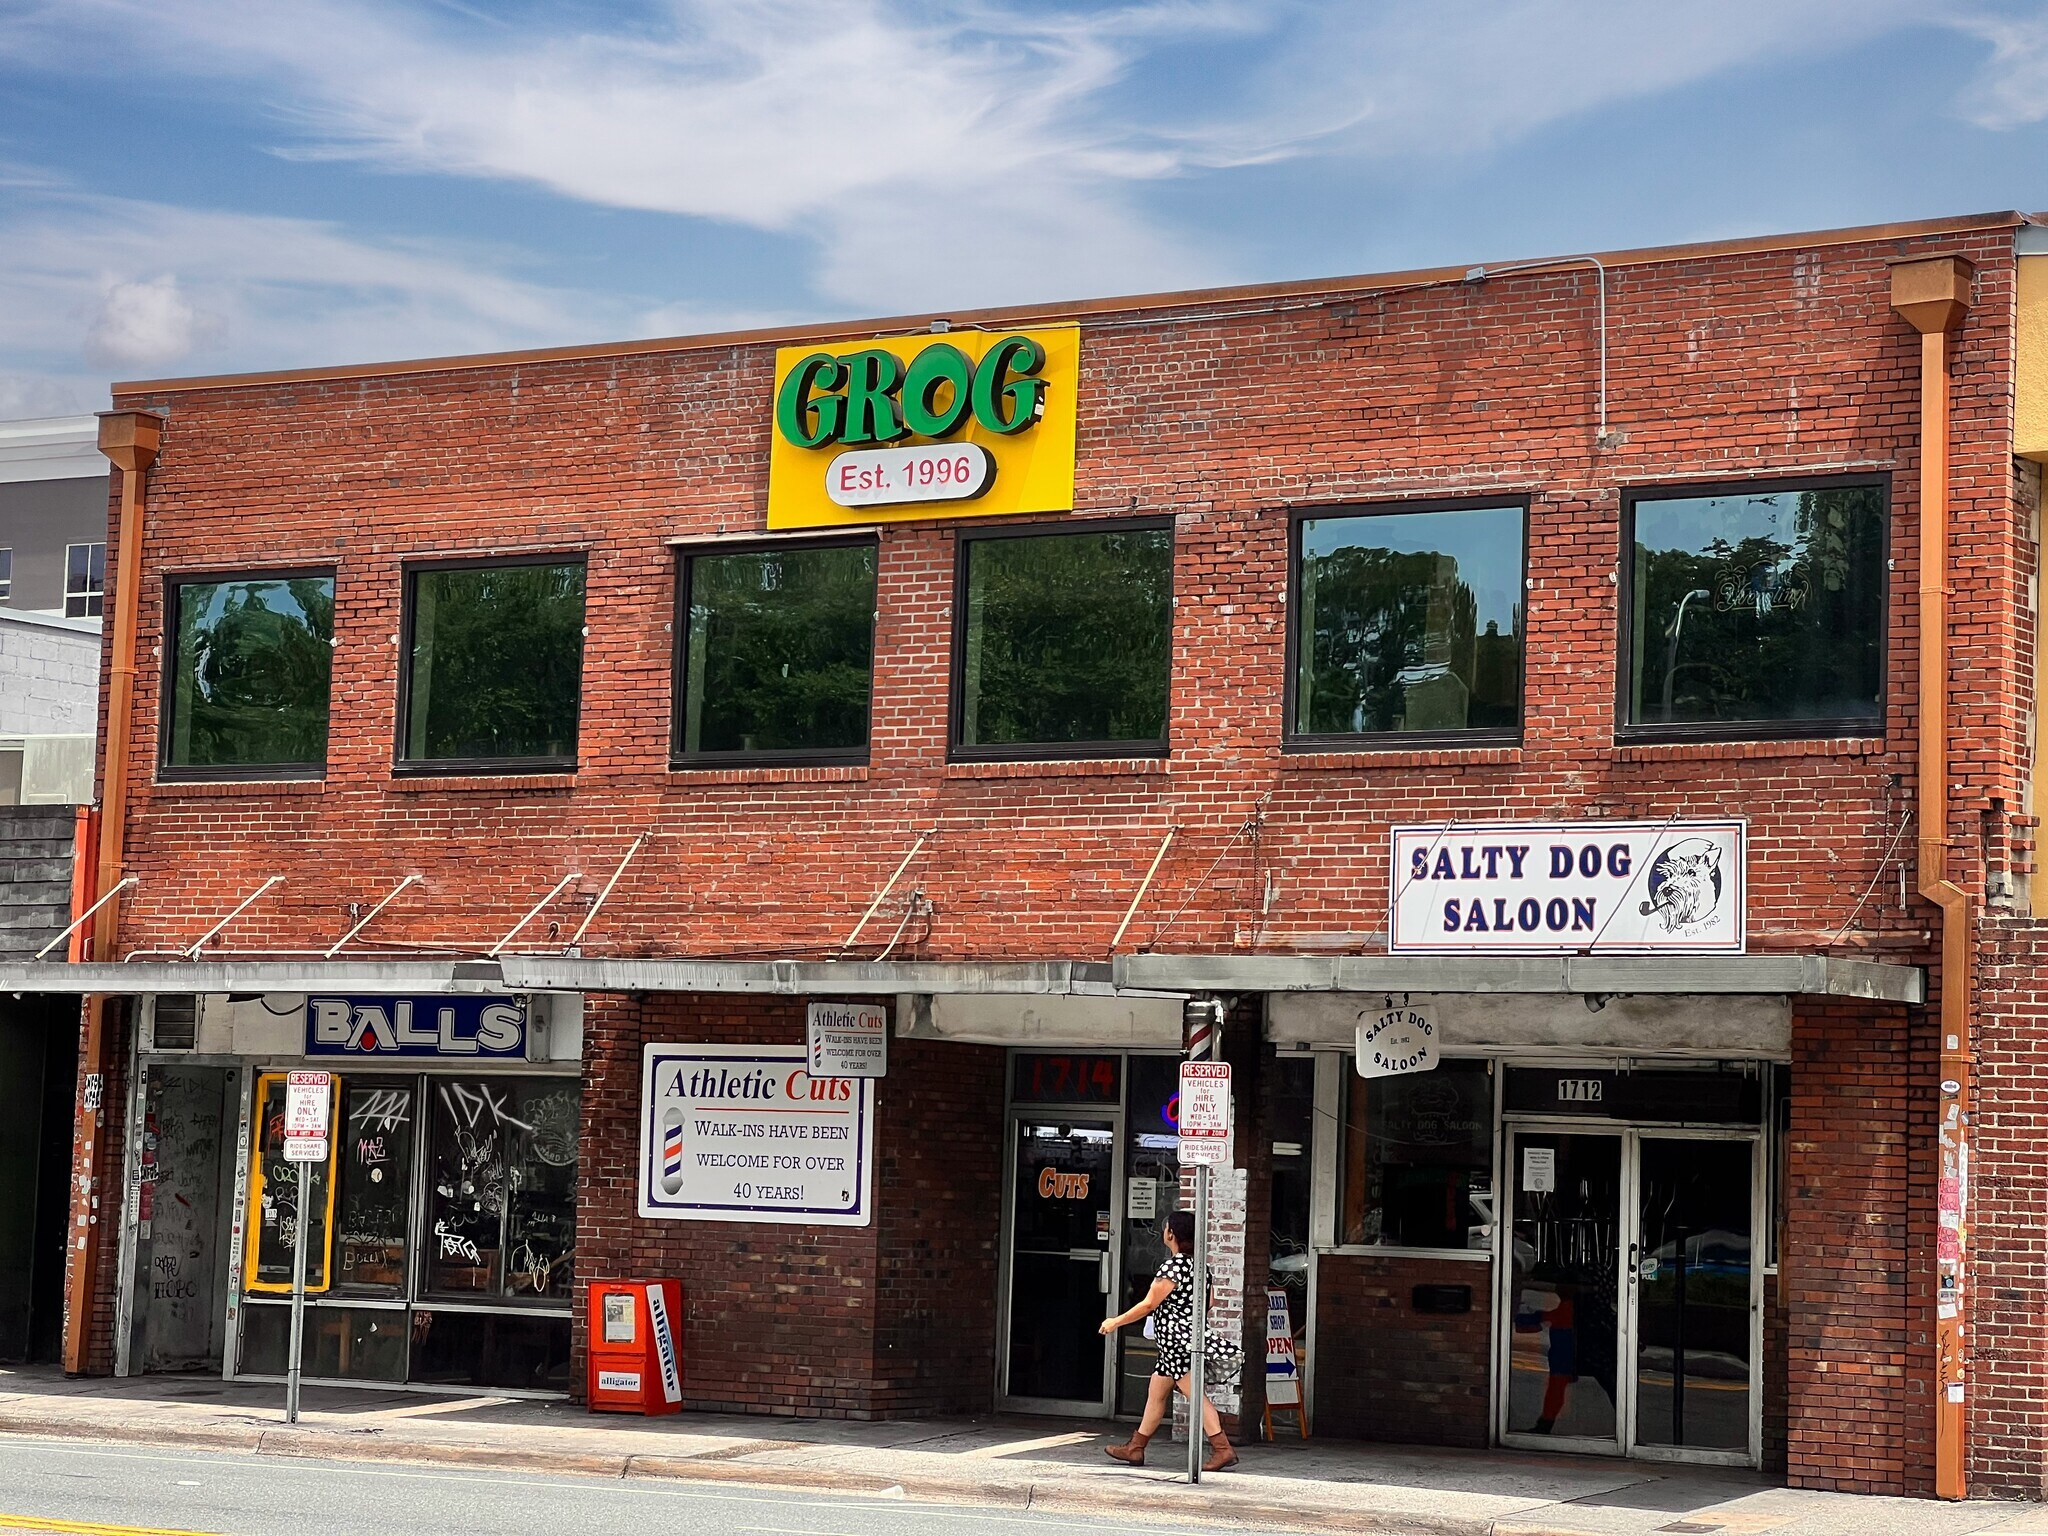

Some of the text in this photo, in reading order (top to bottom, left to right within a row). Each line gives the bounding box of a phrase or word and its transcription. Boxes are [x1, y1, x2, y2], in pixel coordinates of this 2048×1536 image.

[777, 335, 1049, 450] GROG
[840, 456, 971, 491] Est. 1996
[1411, 843, 1633, 880] SALTY DOG
[1443, 896, 1598, 932] SALOON
[1684, 915, 1722, 938] Est. 1982
[310, 998, 525, 1053] BALLS
[812, 1010, 883, 1029] Athletic Cuts
[1366, 1011, 1433, 1042] SALTY DOG
[825, 1034, 883, 1045] WALK-INS HAVE BEEN
[826, 1048, 882, 1058] WELCOME FOR OVER
[1374, 1046, 1427, 1071] SALOON
[840, 1060, 868, 1070] 40 YEARS!
[1184, 1064, 1228, 1077] RESERVED
[290, 1073, 328, 1085] RESERVED
[664, 1068, 851, 1101] Athletic Cuts
[1032, 1056, 1114, 1096] 1714
[1187, 1080, 1224, 1088] VEHICLES
[1560, 1080, 1601, 1100] 1712
[297, 1107, 318, 1116] ONLY
[439, 1082, 533, 1130] IDK
[1192, 1103, 1217, 1113] ONLY
[694, 1120, 850, 1140] WALK-INS HAVE BEEN
[1417, 1120, 1438, 1130] DOG
[1444, 1120, 1482, 1131] SALOON
[696, 1153, 845, 1171] WELCOME FOR OVER
[1186, 1151, 1220, 1159] SEVICES
[733, 1182, 804, 1200] 40 YEARS!
[1038, 1166, 1090, 1200] CUTS
[1269, 1314, 1286, 1331] SHOP
[652, 1298, 675, 1391] alligator
[601, 1377, 638, 1387] alligator
